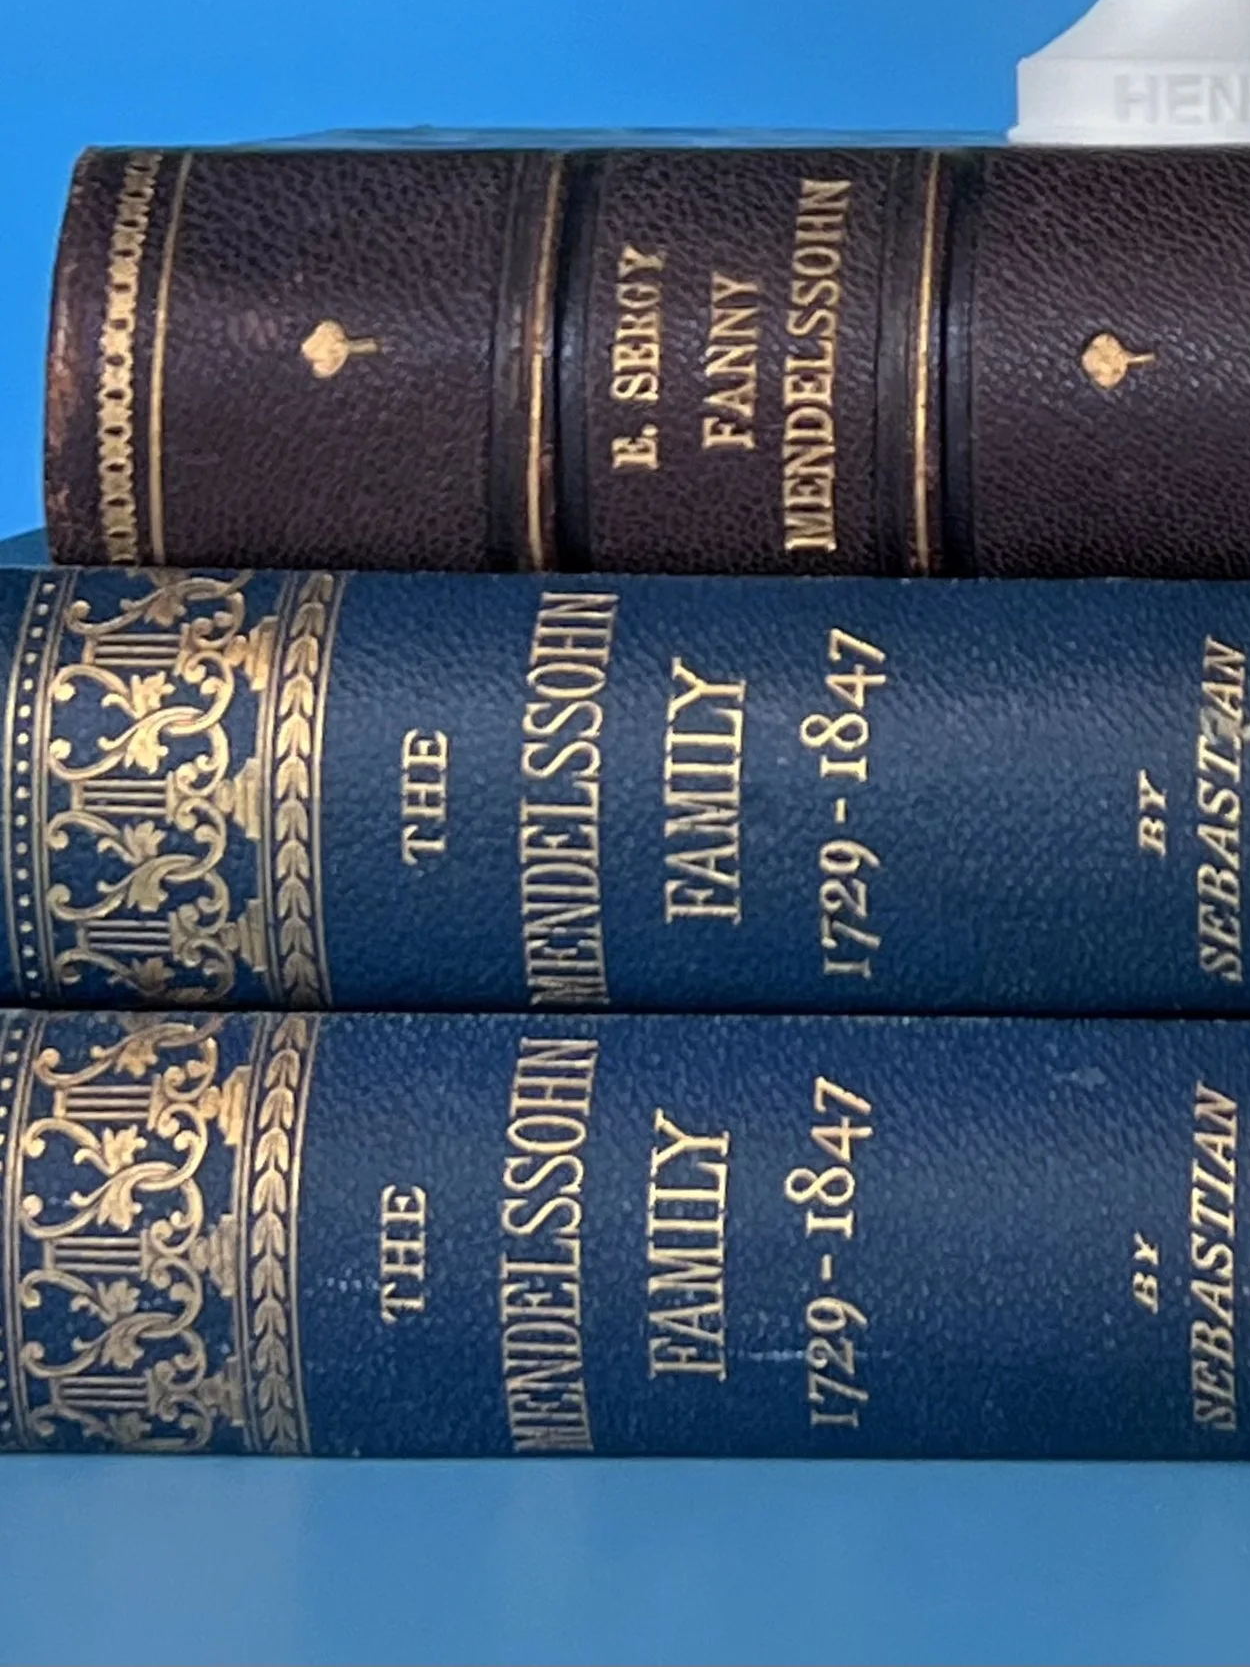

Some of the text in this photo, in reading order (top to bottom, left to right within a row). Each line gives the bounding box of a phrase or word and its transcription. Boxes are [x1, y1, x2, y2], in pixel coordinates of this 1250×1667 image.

[610, 244, 667, 471] E. SERGY
[703, 271, 761, 451] FANNY
[784, 178, 852, 553] MENDELSSOHN
[400, 729, 449, 866] THE
[520, 591, 620, 1006] MENDELSSOHN
[664, 656, 746, 925] FAMILY
[1138, 769, 1167, 859] BY
[381, 1184, 427, 1326] THE
[502, 1036, 599, 1453] MENDELSSOHN
[648, 1107, 730, 1382] FAMILY
[1132, 1231, 1160, 1315] BY
[1190, 1080, 1238, 1431] SEBASTIAN
